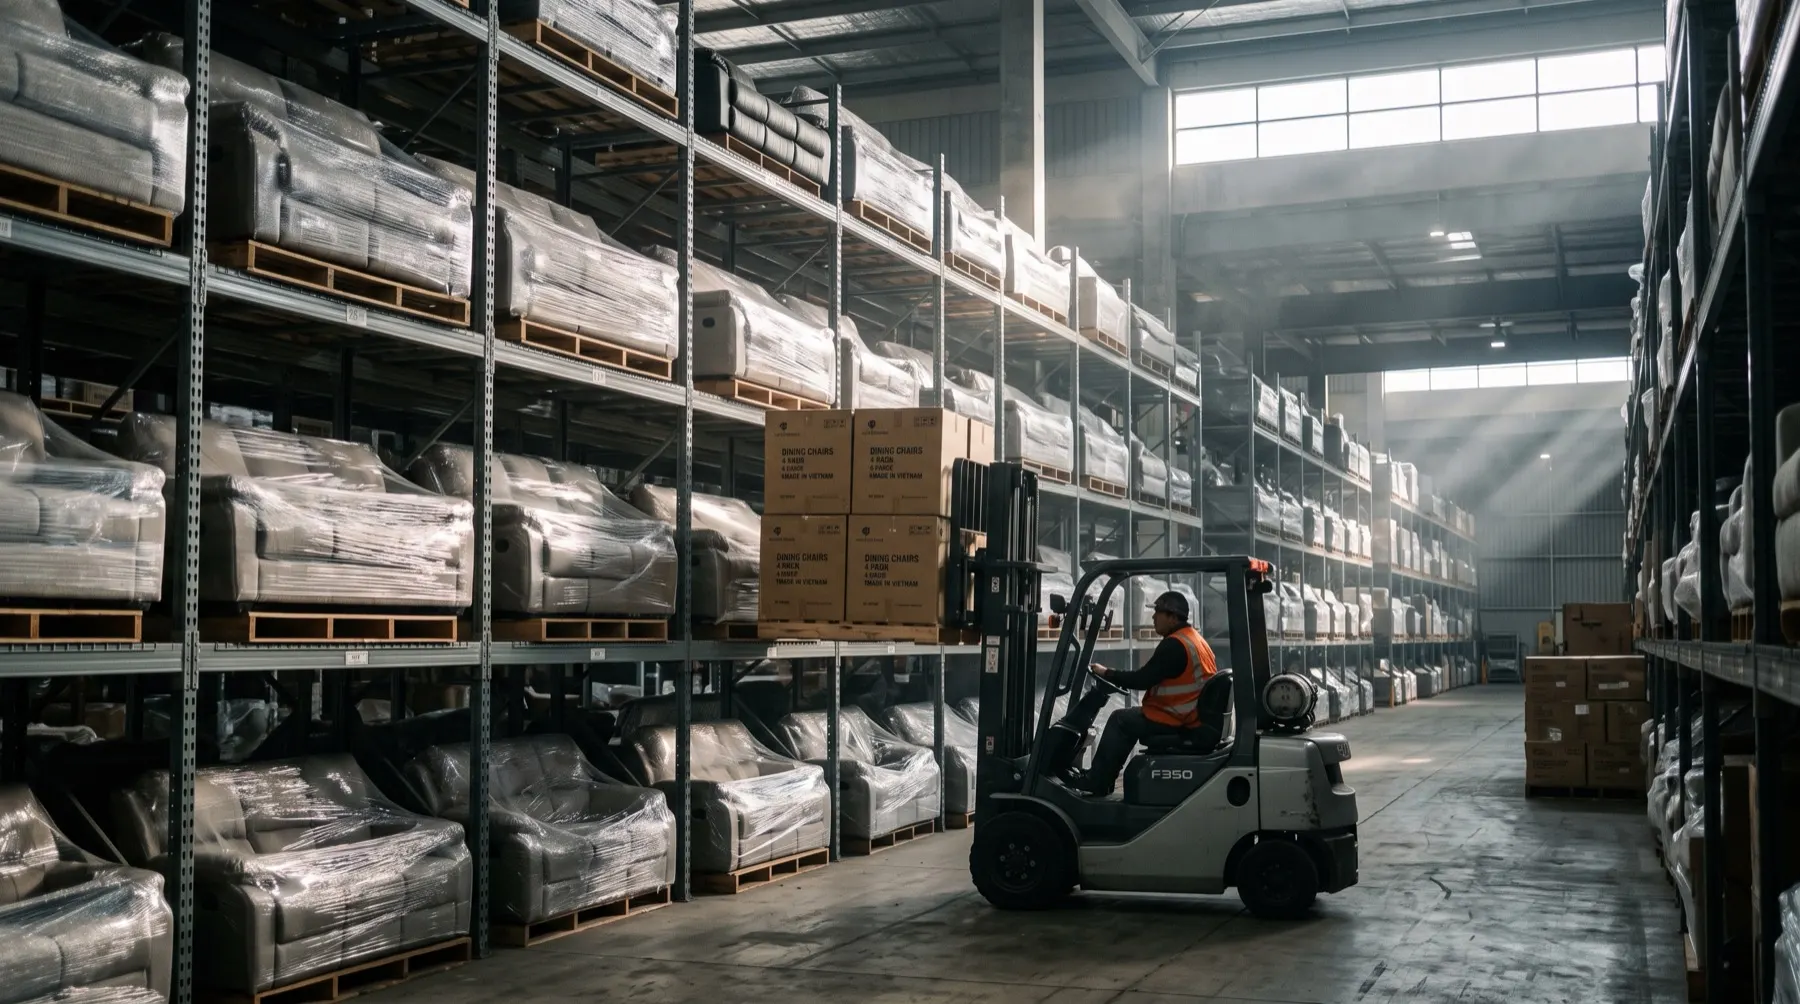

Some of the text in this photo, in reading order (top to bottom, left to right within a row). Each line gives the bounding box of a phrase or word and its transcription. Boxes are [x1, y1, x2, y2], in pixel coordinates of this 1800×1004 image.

[781, 447, 834, 456] DINING CHAIRS
[870, 446, 923, 455] DINING CHAIRS
[776, 552, 828, 561] DINING CHAIRS
[864, 554, 919, 563] DINING CHAIRS
[1152, 770, 1193, 779] F350
